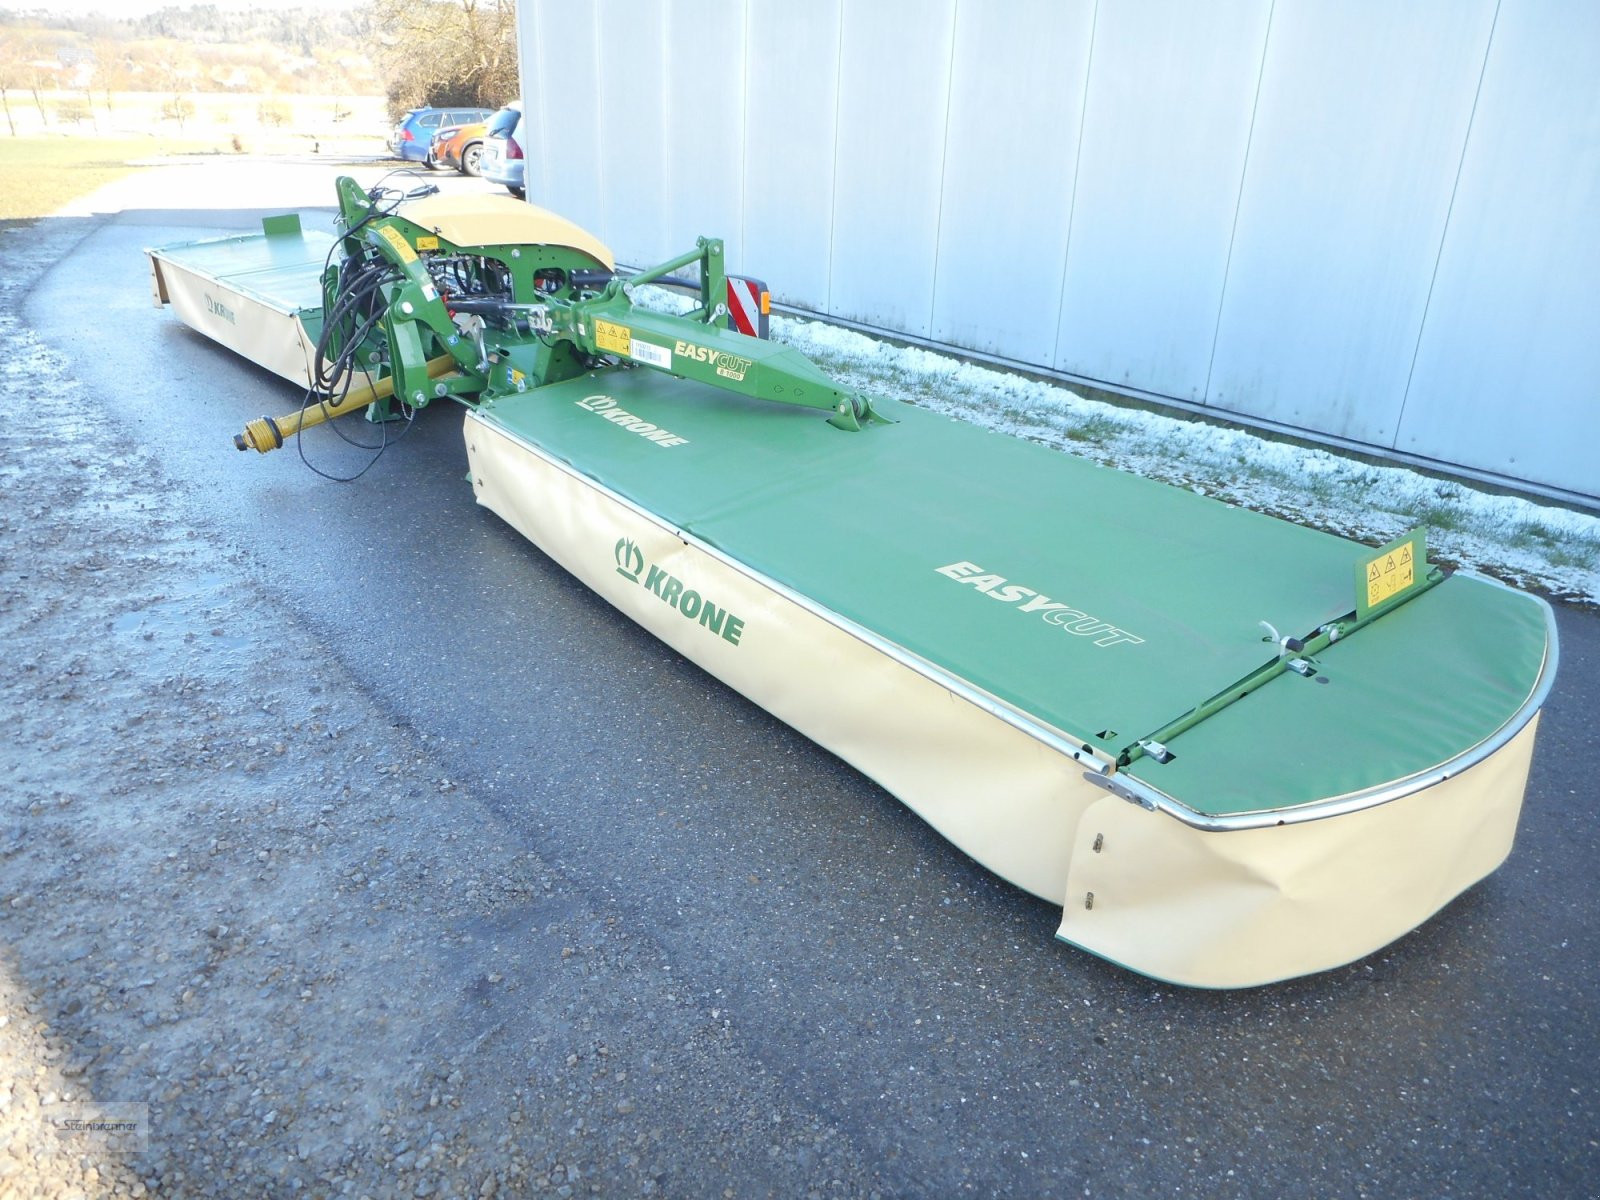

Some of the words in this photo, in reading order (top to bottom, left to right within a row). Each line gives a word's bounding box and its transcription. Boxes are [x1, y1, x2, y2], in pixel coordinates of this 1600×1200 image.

[674, 340, 752, 374] EASYCUT
[594, 407, 690, 448] KRONE
[644, 563, 745, 647] KRONE
[933, 560, 1146, 648] EASYCUT
